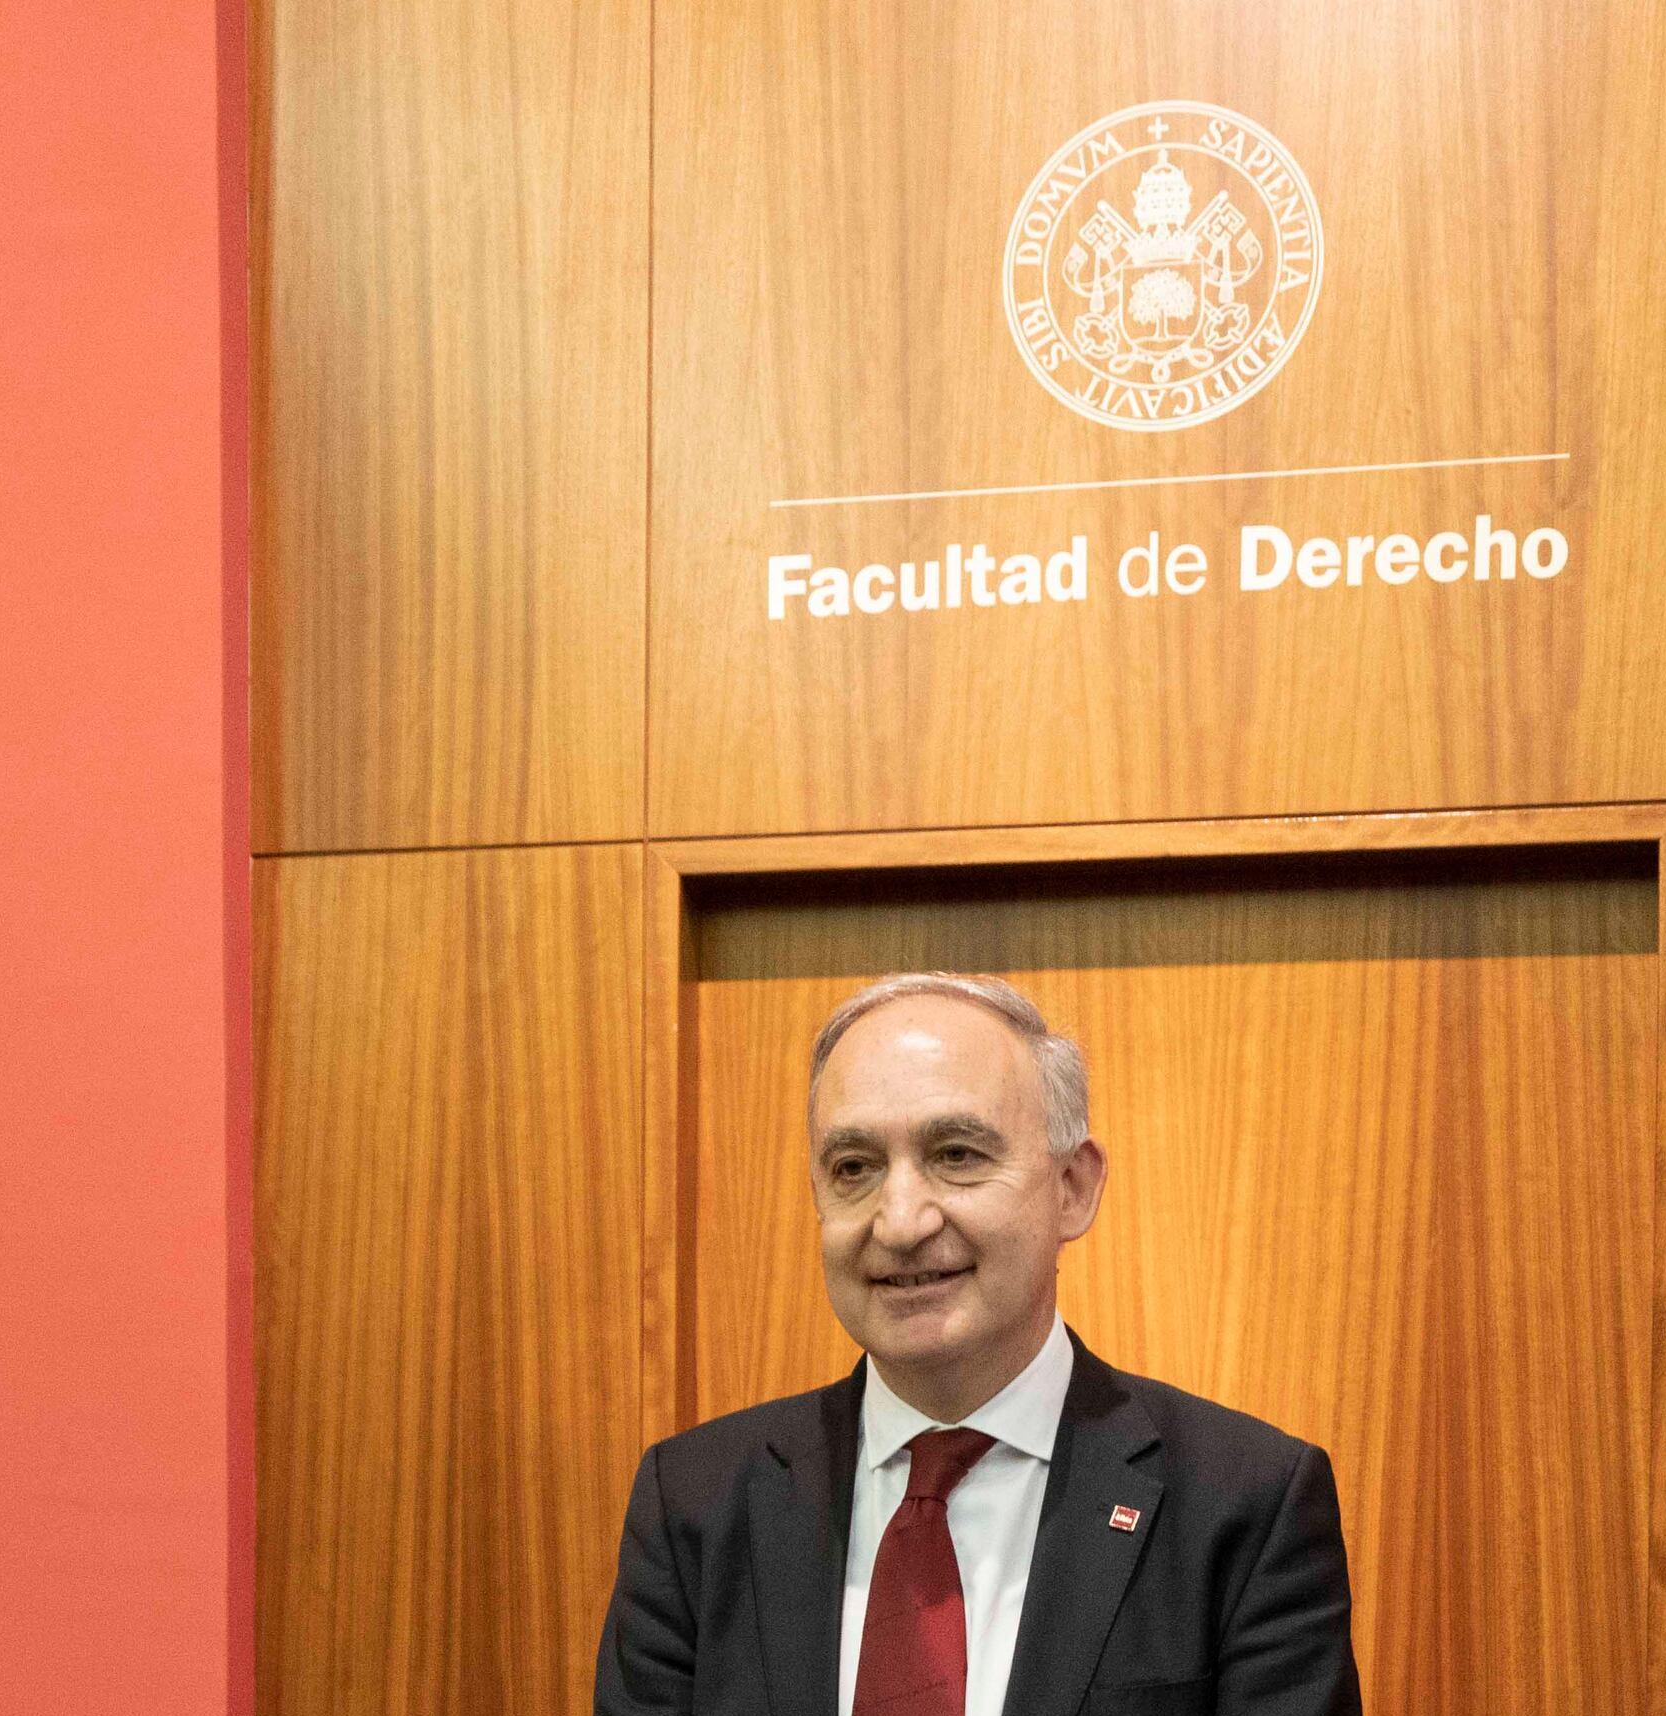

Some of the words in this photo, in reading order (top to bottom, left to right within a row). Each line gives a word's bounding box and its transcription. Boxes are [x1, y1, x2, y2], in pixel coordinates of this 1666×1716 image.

[1015, 131, 1125, 266] DOMVM
[1199, 118, 1313, 292] SAPIENTIA
[1017, 297, 1070, 371] SIBI
[768, 535, 1087, 620] Facultad
[1118, 532, 1206, 597] de
[1240, 514, 1569, 592] Derecho
